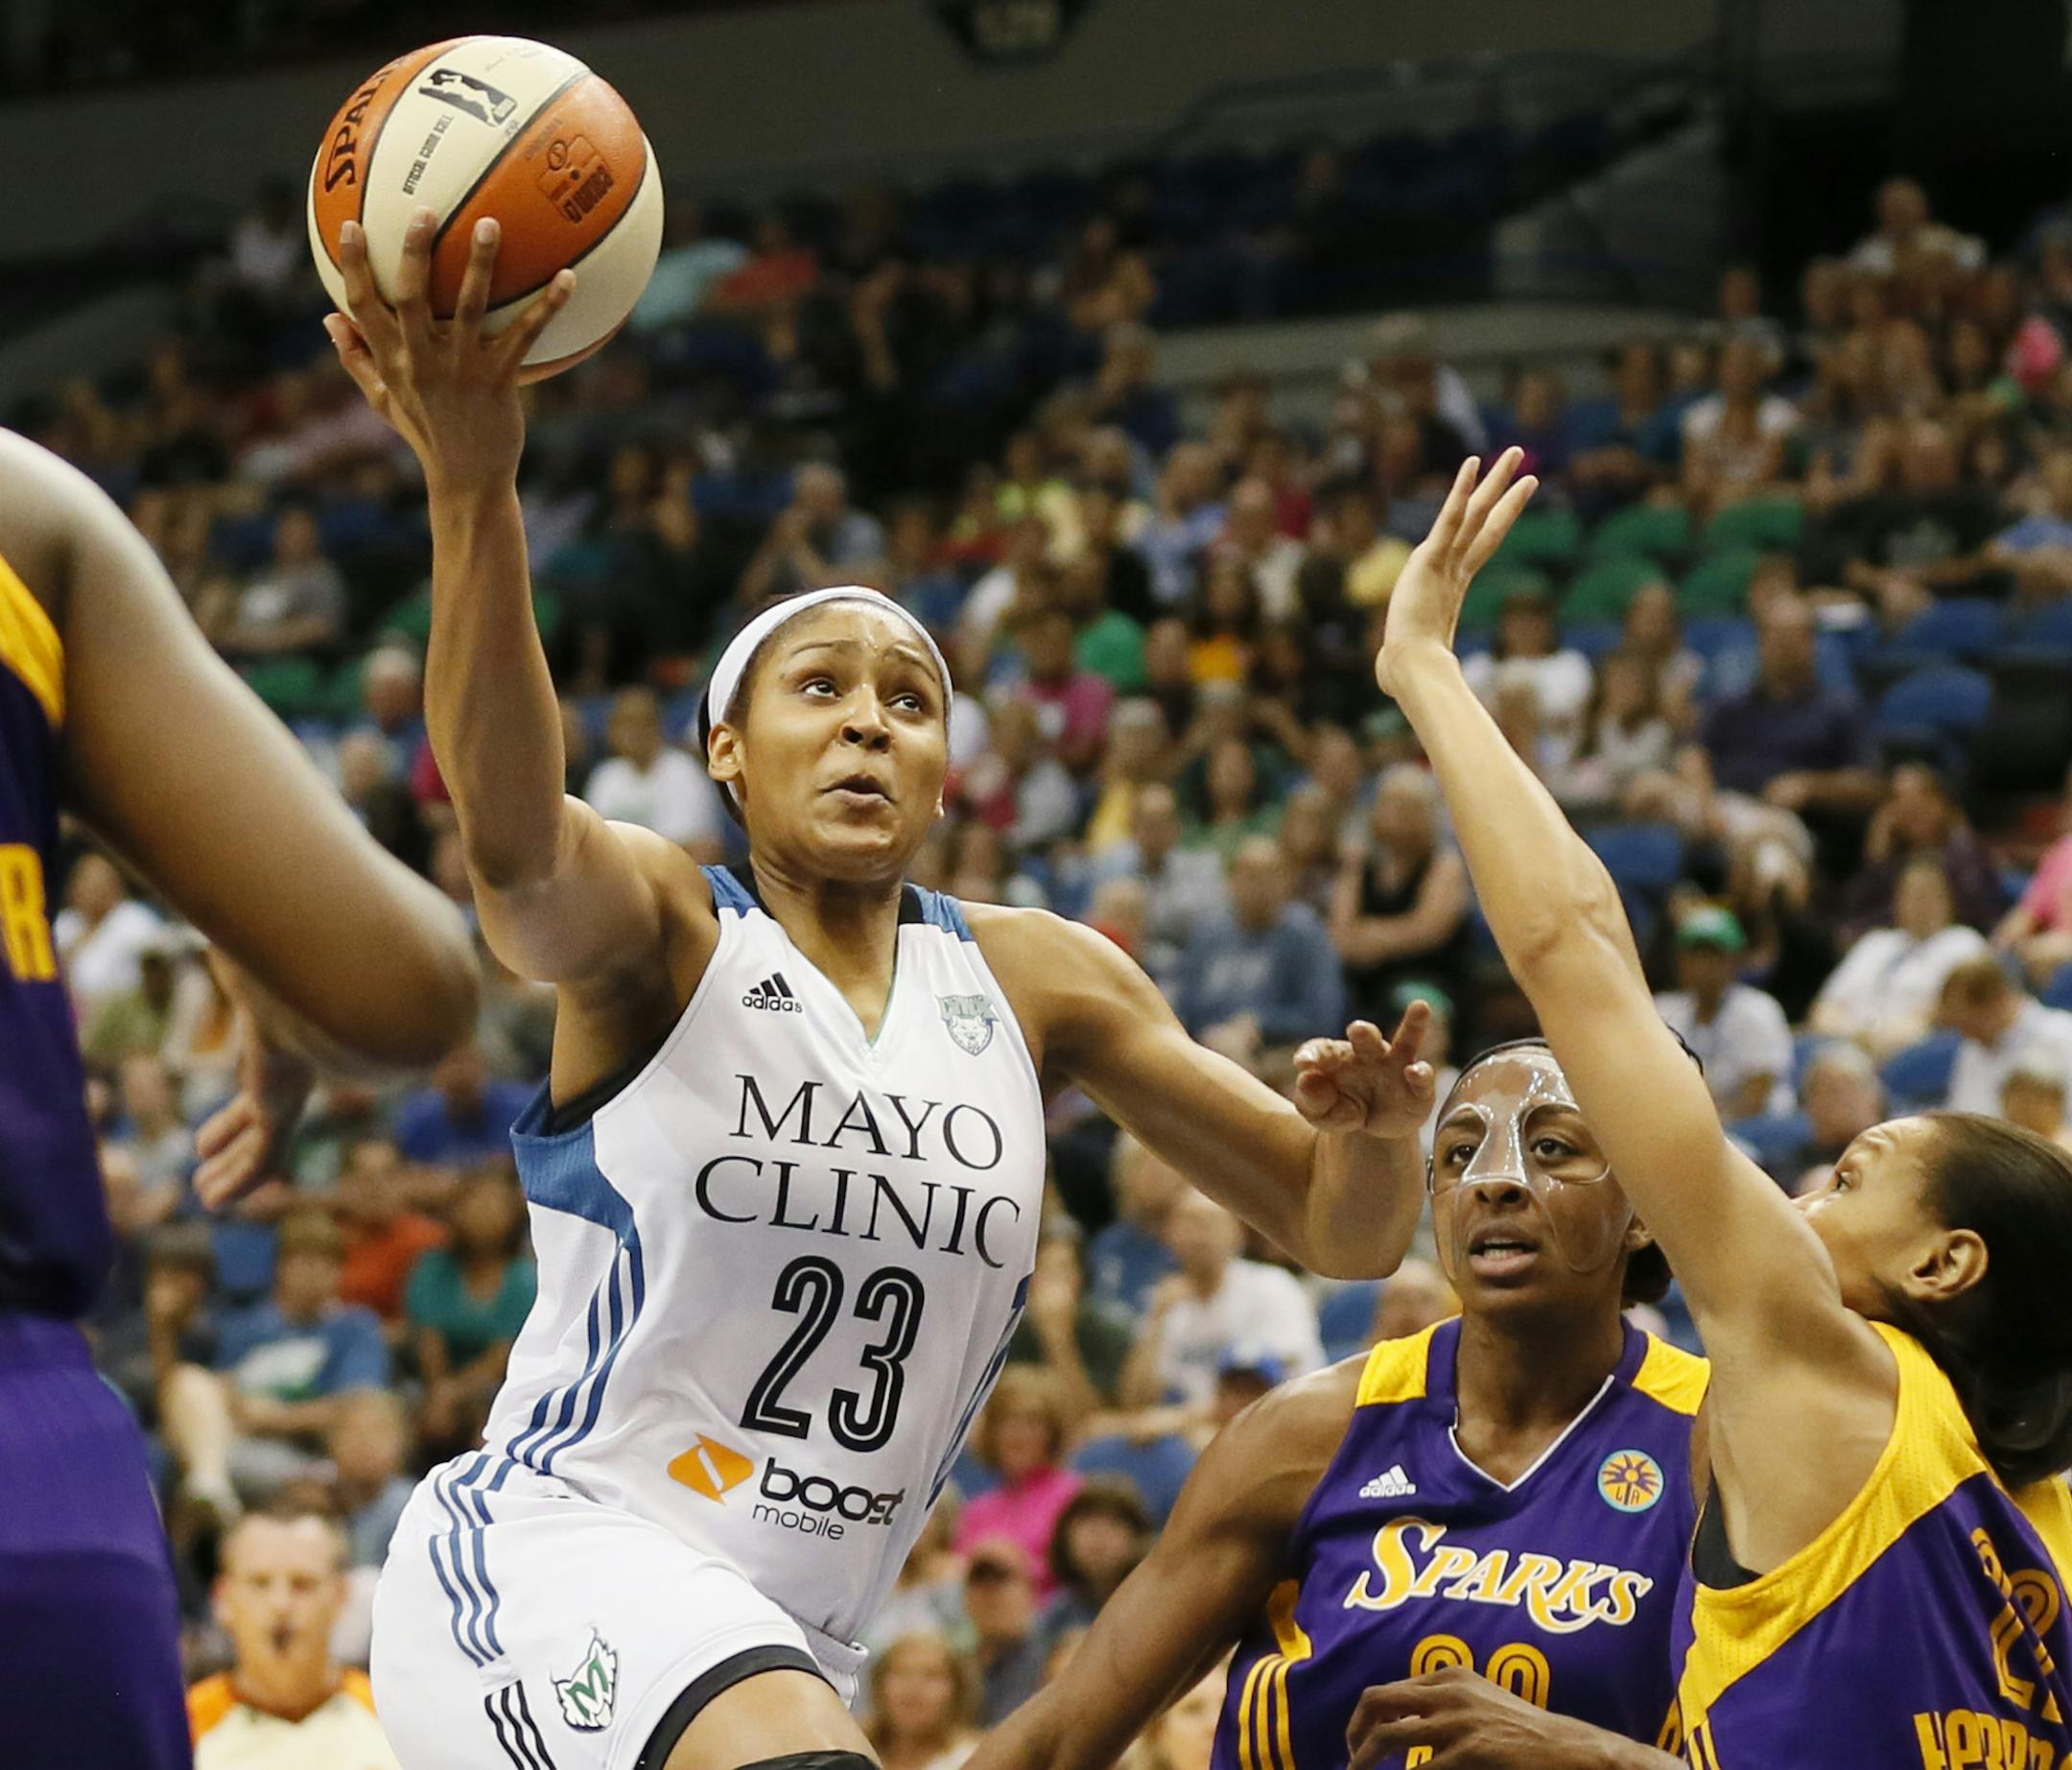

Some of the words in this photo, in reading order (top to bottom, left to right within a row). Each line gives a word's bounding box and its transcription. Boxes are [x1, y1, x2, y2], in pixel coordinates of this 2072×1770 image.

[742, 995, 803, 1013] adidas
[728, 1074, 1003, 1170] MAYO
[695, 1155, 1022, 1269] CLINIC
[739, 1255, 926, 1453] 23
[752, 1503, 845, 1541] mobile
[1358, 1482, 1417, 1499] adidas
[1343, 1515, 1655, 1635] SPARKS
